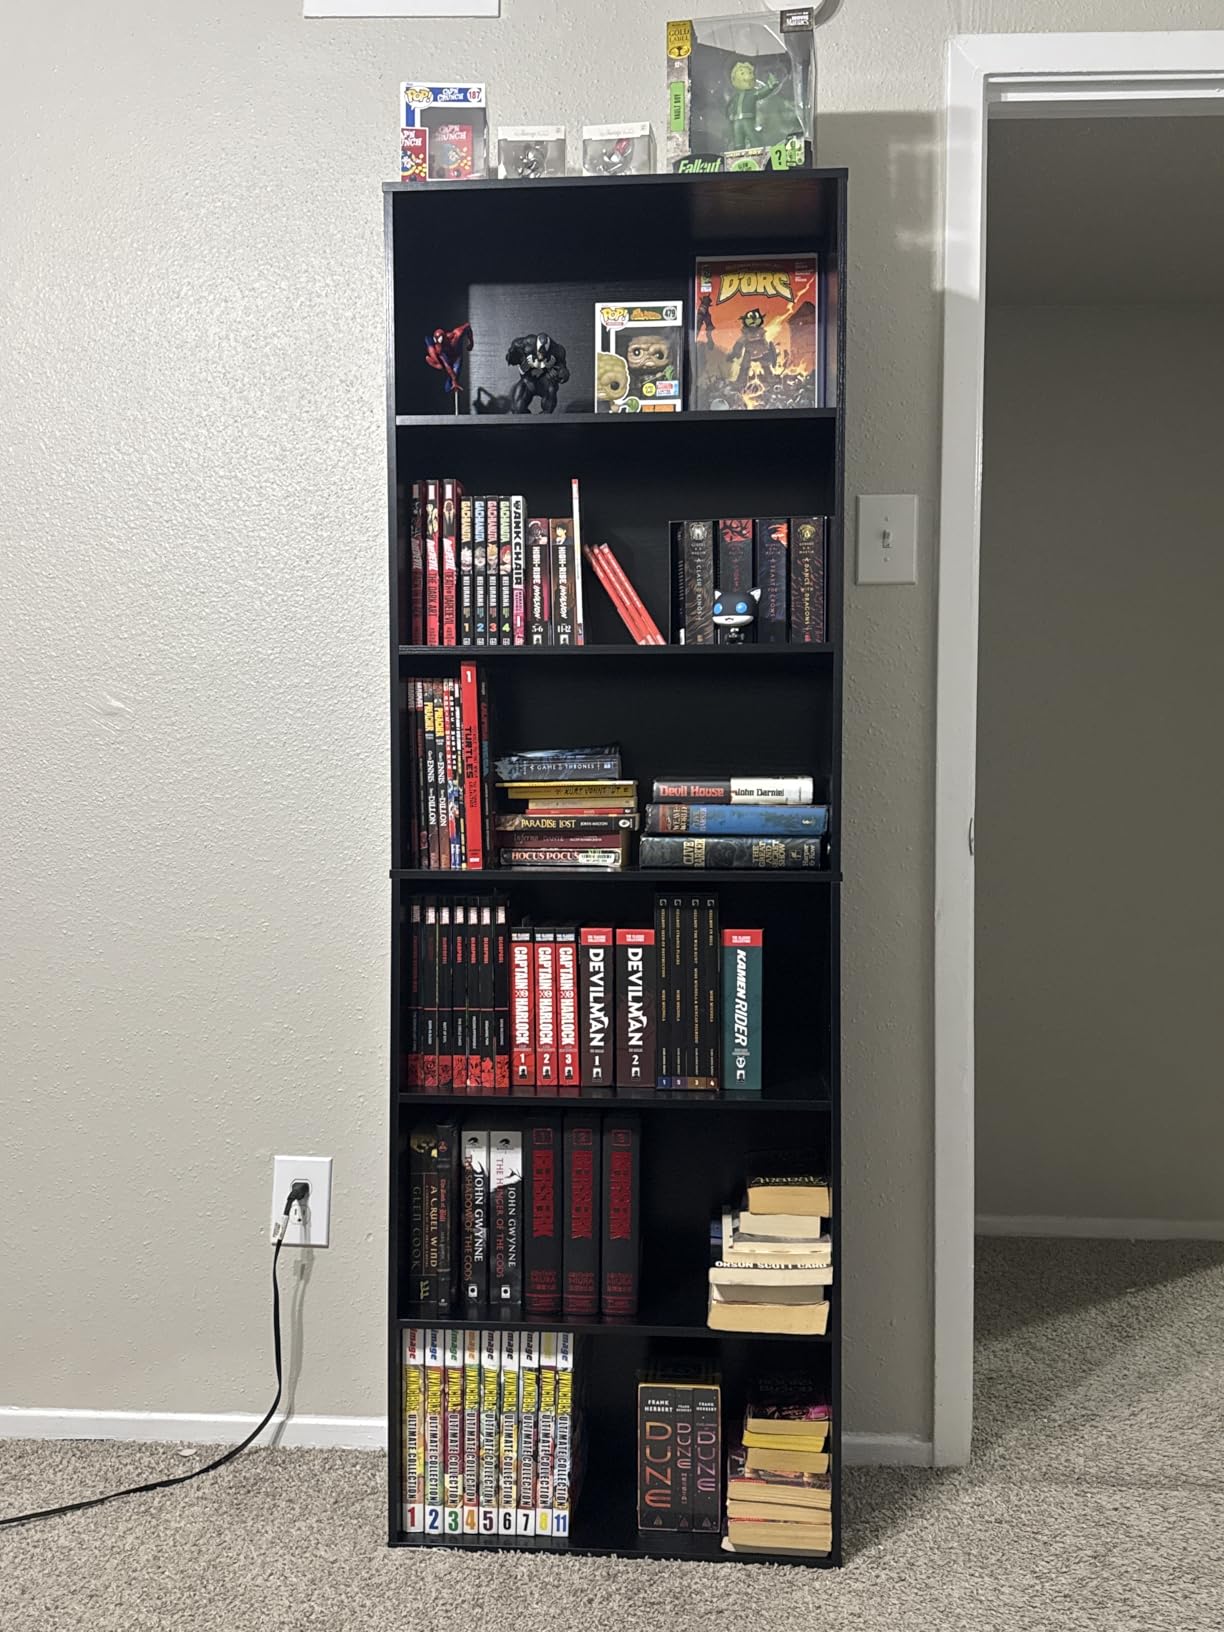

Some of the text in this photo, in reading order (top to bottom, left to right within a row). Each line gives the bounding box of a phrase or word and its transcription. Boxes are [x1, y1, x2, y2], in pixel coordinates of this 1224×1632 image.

[668, 28, 690, 36] GOLD
[405, 89, 431, 103] POP!
[468, 90, 480, 100] 187
[679, 158, 721, 174] Fallout
[600, 307, 628, 322] POP!
[664, 309, 676, 318] 479
[514, 542, 522, 585] CHAIR
[428, 573, 436, 584] THE
[445, 572, 454, 590] DEATH
[532, 546, 541, 619] HIGH-RISE INVASION
[558, 546, 568, 619] HIGH-RISE INVASION
[428, 586, 436, 602] DARK
[428, 604, 436, 616] ART
[445, 594, 454, 624] DAREDEVIL
[464, 623, 469, 632] 1
[476, 623, 484, 632] 2
[489, 623, 497, 632] 3
[502, 623, 510, 632] 4
[466, 671, 472, 682] 1
[465, 726, 473, 779] TURTLES
[660, 786, 724, 796] Devil House
[521, 819, 577, 828] PARADISE LOST
[512, 851, 545, 860] HOCUS
[546, 851, 579, 860] POCUS
[683, 841, 694, 864] CLIVE
[694, 839, 706, 868] BARKER
[736, 949, 746, 999] KAMEN
[514, 946, 530, 1045] CAPTAIN HARLOCK
[538, 947, 553, 1045] CAPTAIN HARLOCK
[559, 947, 575, 1045] CAPTAIN HARLOCK
[589, 948, 609, 1046] DEVILMAN
[628, 948, 648, 1045] DEVILMAN
[734, 998, 748, 1046] RIDER
[520, 1054, 525, 1063] 1
[544, 1054, 550, 1063] 2
[566, 1054, 572, 1063] 3
[594, 1056, 600, 1065] 1
[632, 1055, 639, 1065] 2
[430, 1186, 438, 1194] A
[412, 1186, 421, 1270] GLEN COOK
[465, 1220, 472, 1232] OF
[474, 1174, 483, 1262] JOHN GWYNNE
[496, 1218, 504, 1230] OF
[508, 1187, 516, 1267] JOHN GWYNNE
[406, 1368, 421, 1411] INVINCIBLE
[427, 1370, 441, 1412] INVINCIBLE
[447, 1369, 462, 1412] INVINCIBLE
[465, 1368, 478, 1409] INVINCIBLE
[484, 1368, 497, 1411] INVINCIBLE
[503, 1370, 517, 1412] INVINCIBLE
[523, 1370, 536, 1412] INVINCIBLE
[542, 1369, 554, 1412] INVINCIBLE
[558, 1372, 572, 1414] INVINCIBLE
[407, 1414, 418, 1499] ULTIMATE COLLECTION
[429, 1416, 439, 1501] ULTIMATE COLLECTION
[448, 1414, 459, 1504] ULTIMATE COLLECTION
[465, 1412, 476, 1502] ULTIMATE COLLECTION
[484, 1414, 495, 1504] ULTIMATE COLLECTION
[503, 1415, 514, 1505] ULTIMATE COLLECTION
[540, 1415, 551, 1505] ULTIMATE COLLECTION
[676, 1423, 692, 1469] DUNE
[522, 1416, 532, 1506] ULTIMATE COLLECTION
[557, 1416, 568, 1507] ULTIMATE COLLECTION
[644, 1421, 672, 1508] DUNE
[697, 1431, 716, 1492] DUNE
[408, 1507, 415, 1527] 1
[429, 1509, 438, 1530] 2
[448, 1511, 458, 1531] 3
[465, 1510, 476, 1530] 4
[483, 1511, 493, 1531] 5
[503, 1513, 512, 1530] 6
[522, 1514, 529, 1531] 7
[540, 1513, 548, 1530] 8
[554, 1515, 566, 1532] 11
